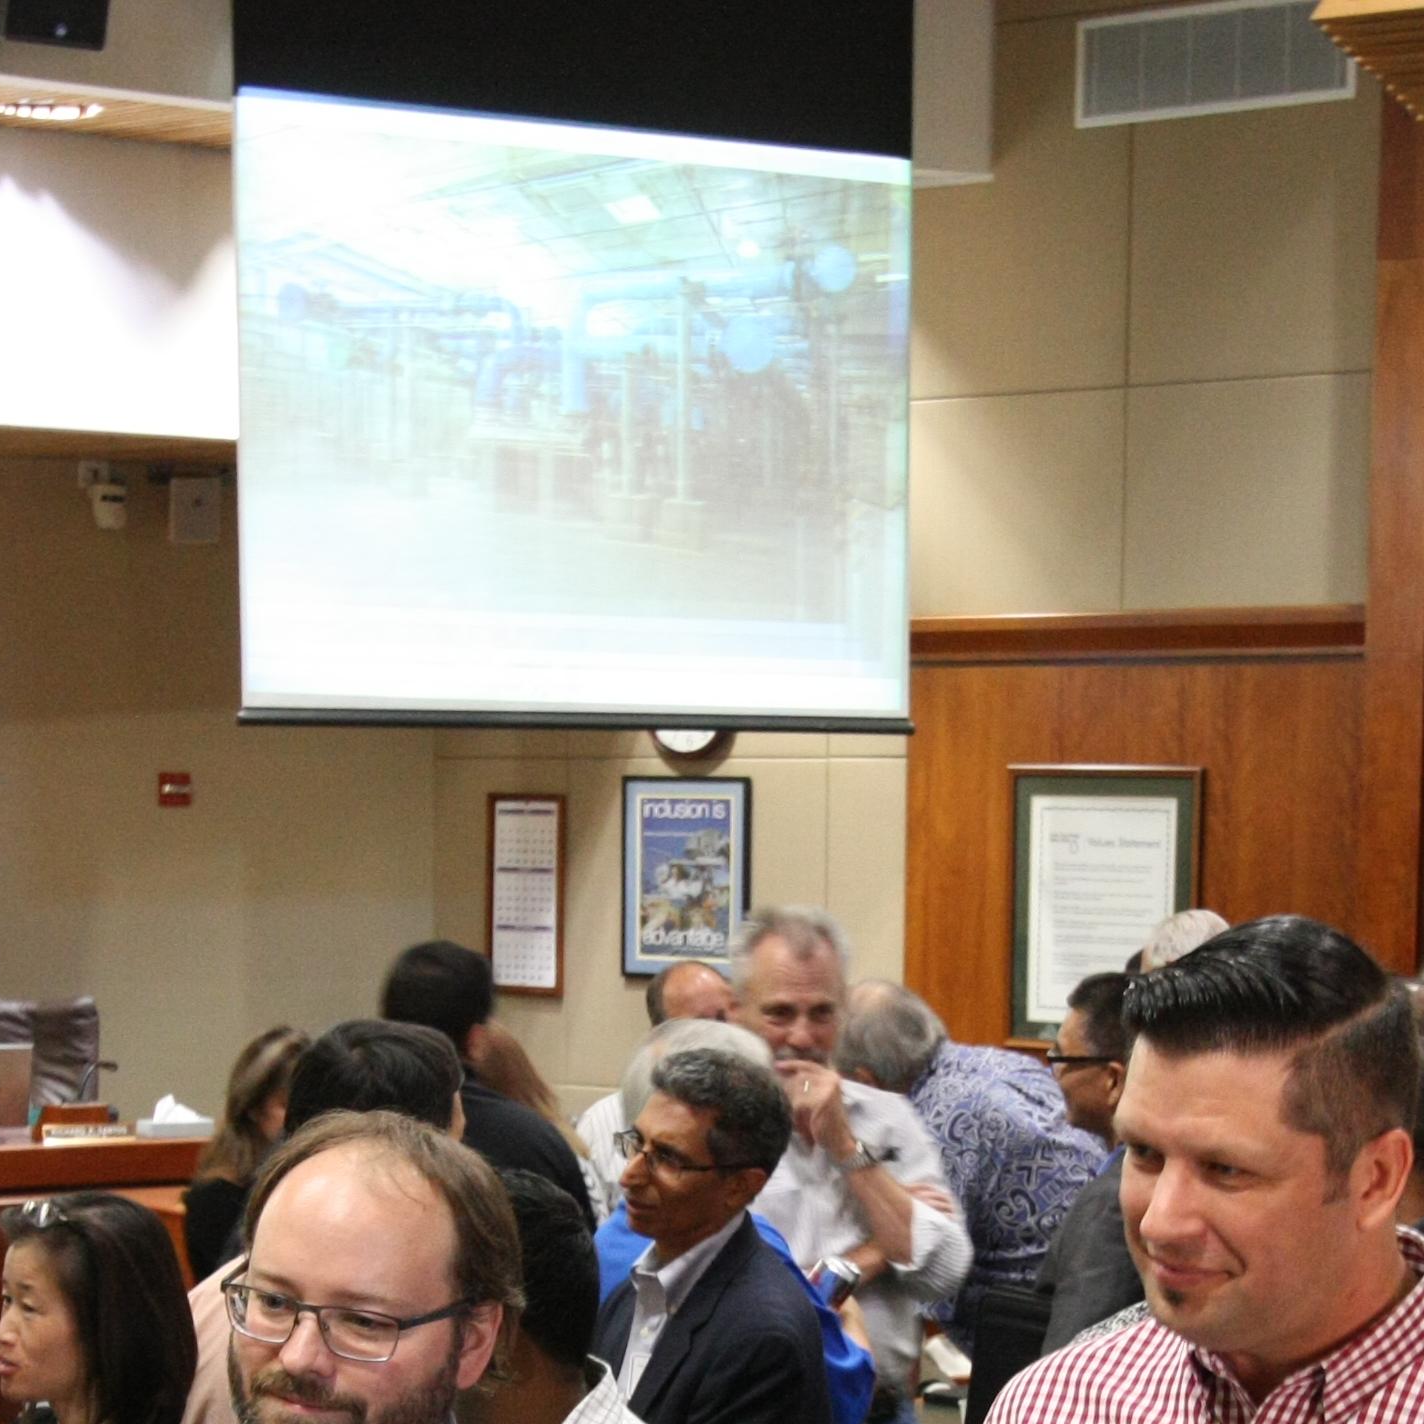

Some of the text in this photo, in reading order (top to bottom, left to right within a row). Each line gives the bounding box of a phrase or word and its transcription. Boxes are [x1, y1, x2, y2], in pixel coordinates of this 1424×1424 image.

[642, 799, 726, 820] inclusion is
[641, 928, 726, 951] advantage
